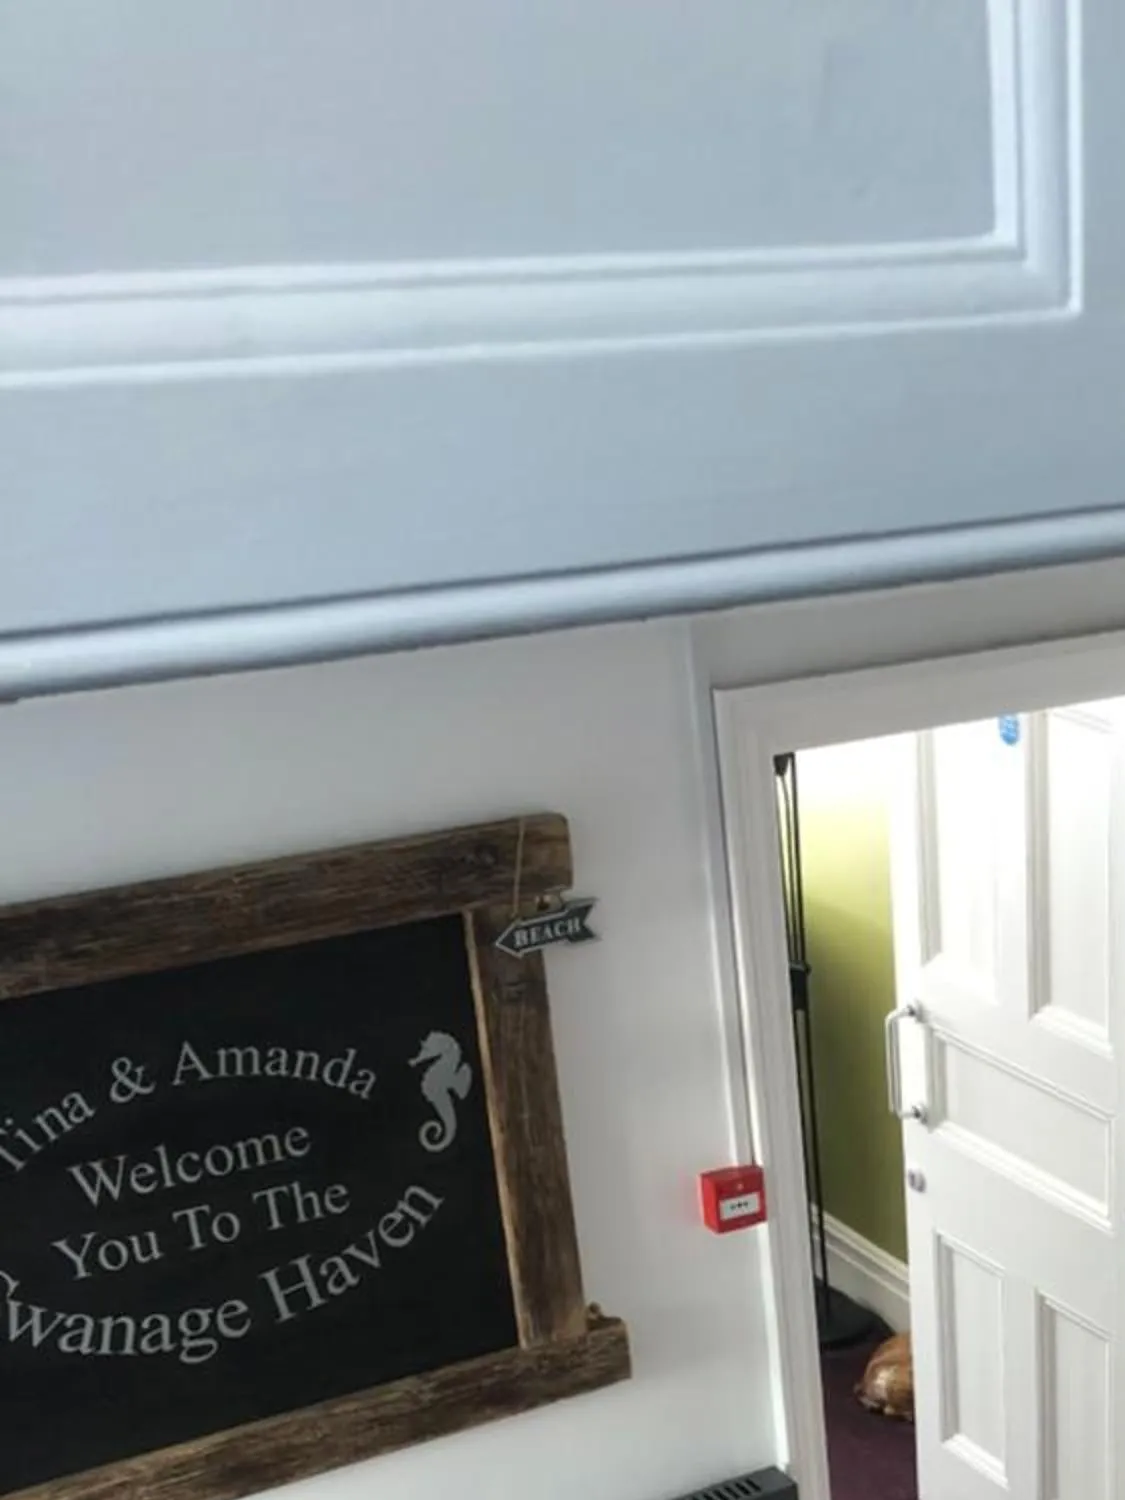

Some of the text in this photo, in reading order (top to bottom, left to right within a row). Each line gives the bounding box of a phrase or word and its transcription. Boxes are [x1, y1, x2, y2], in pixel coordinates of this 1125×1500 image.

[513, 918, 580, 949] BEACH
[108, 1056, 156, 1103] &
[171, 1039, 378, 1100] Amanda
[66, 1124, 313, 1208] Welcome
[51, 1180, 351, 1282] You To The
[260, 1184, 445, 1323] Haven
